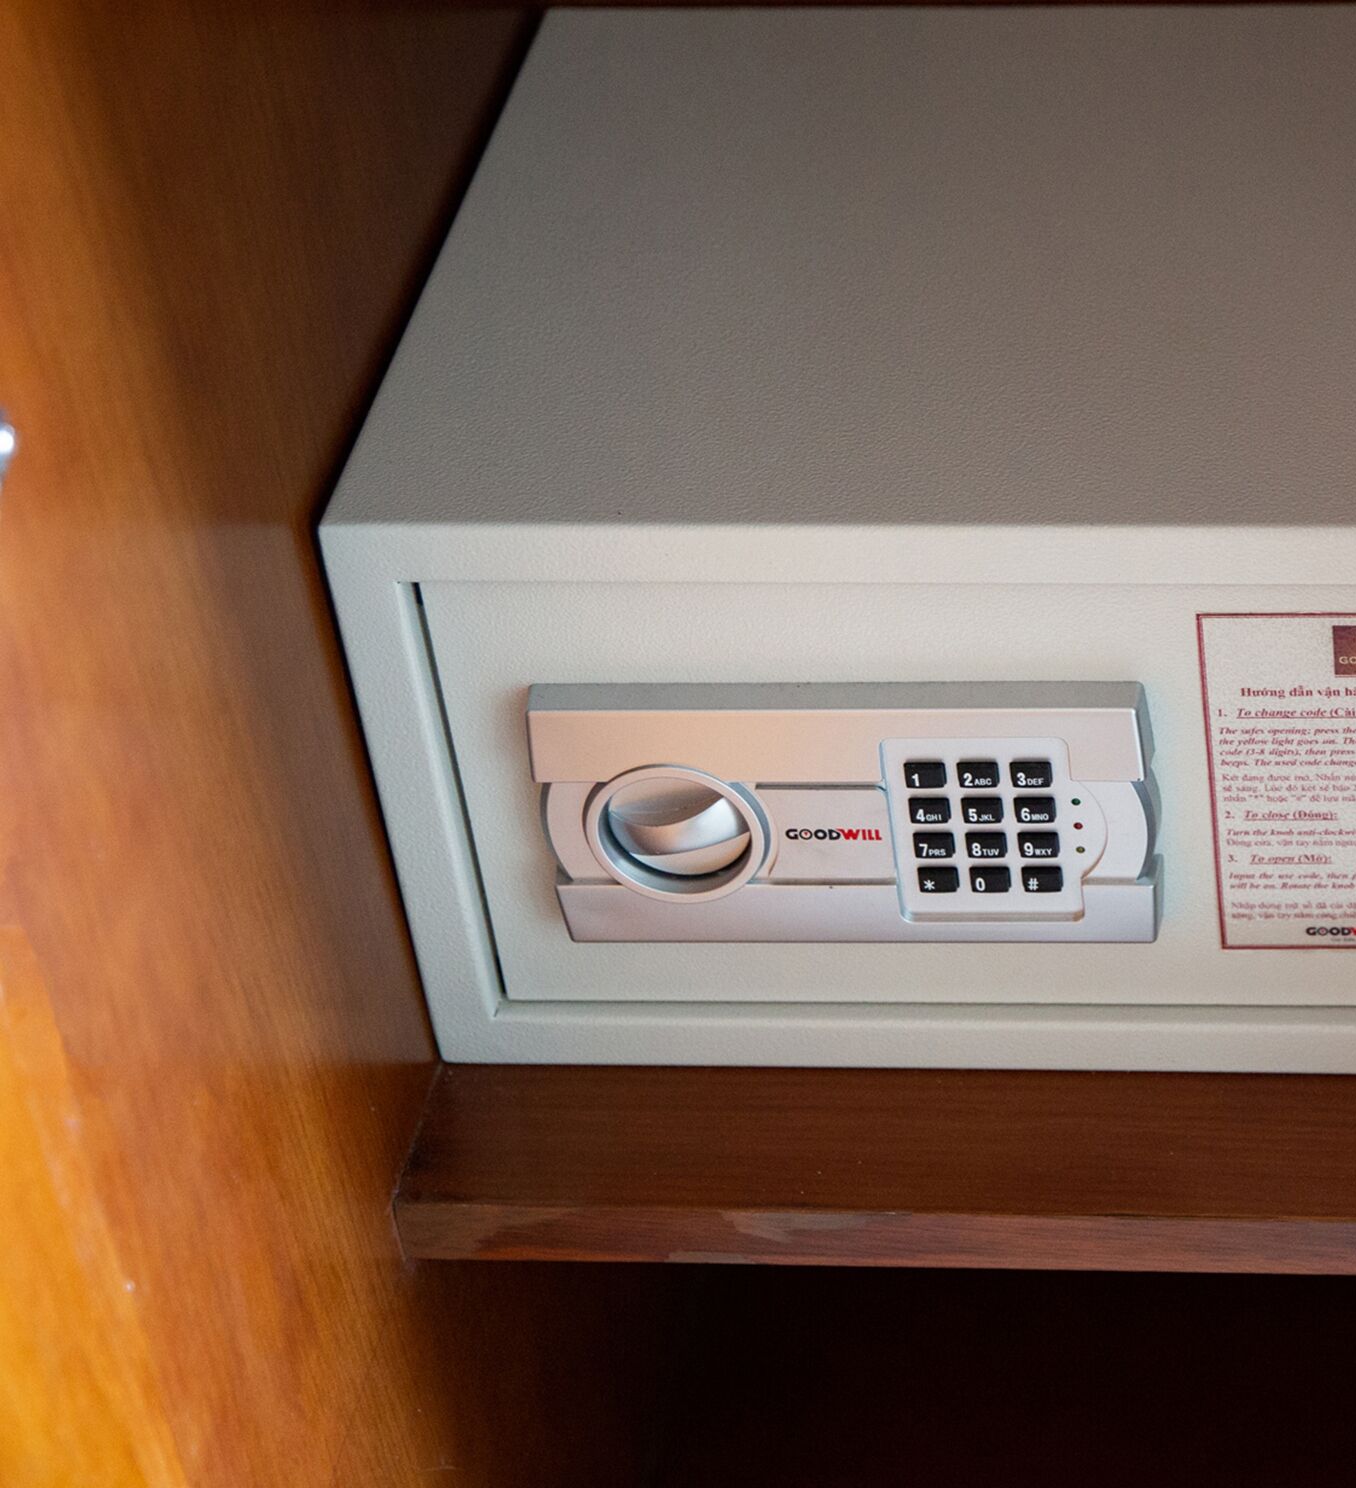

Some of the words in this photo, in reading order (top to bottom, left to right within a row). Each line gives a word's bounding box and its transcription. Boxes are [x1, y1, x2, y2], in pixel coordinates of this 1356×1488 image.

[1240, 687, 1286, 698] Hướng
[1289, 685, 1313, 697] dẫn
[1317, 687, 1341, 698] vận
[1217, 708, 1228, 717] 1.
[1237, 708, 1251, 718] To
[1255, 708, 1296, 718] change
[1300, 708, 1326, 717] code
[1220, 726, 1237, 734] The
[912, 774, 920, 786] 1
[1225, 811, 1234, 819] 2.
[1244, 810, 1258, 820] To
[1262, 810, 1290, 820] close
[785, 828, 882, 840] GOODWILL
[1228, 854, 1238, 862] 3.
[1250, 854, 1264, 864] To
[1267, 856, 1294, 864] open
[975, 878, 986, 891] 0
[1028, 878, 1039, 890] #
